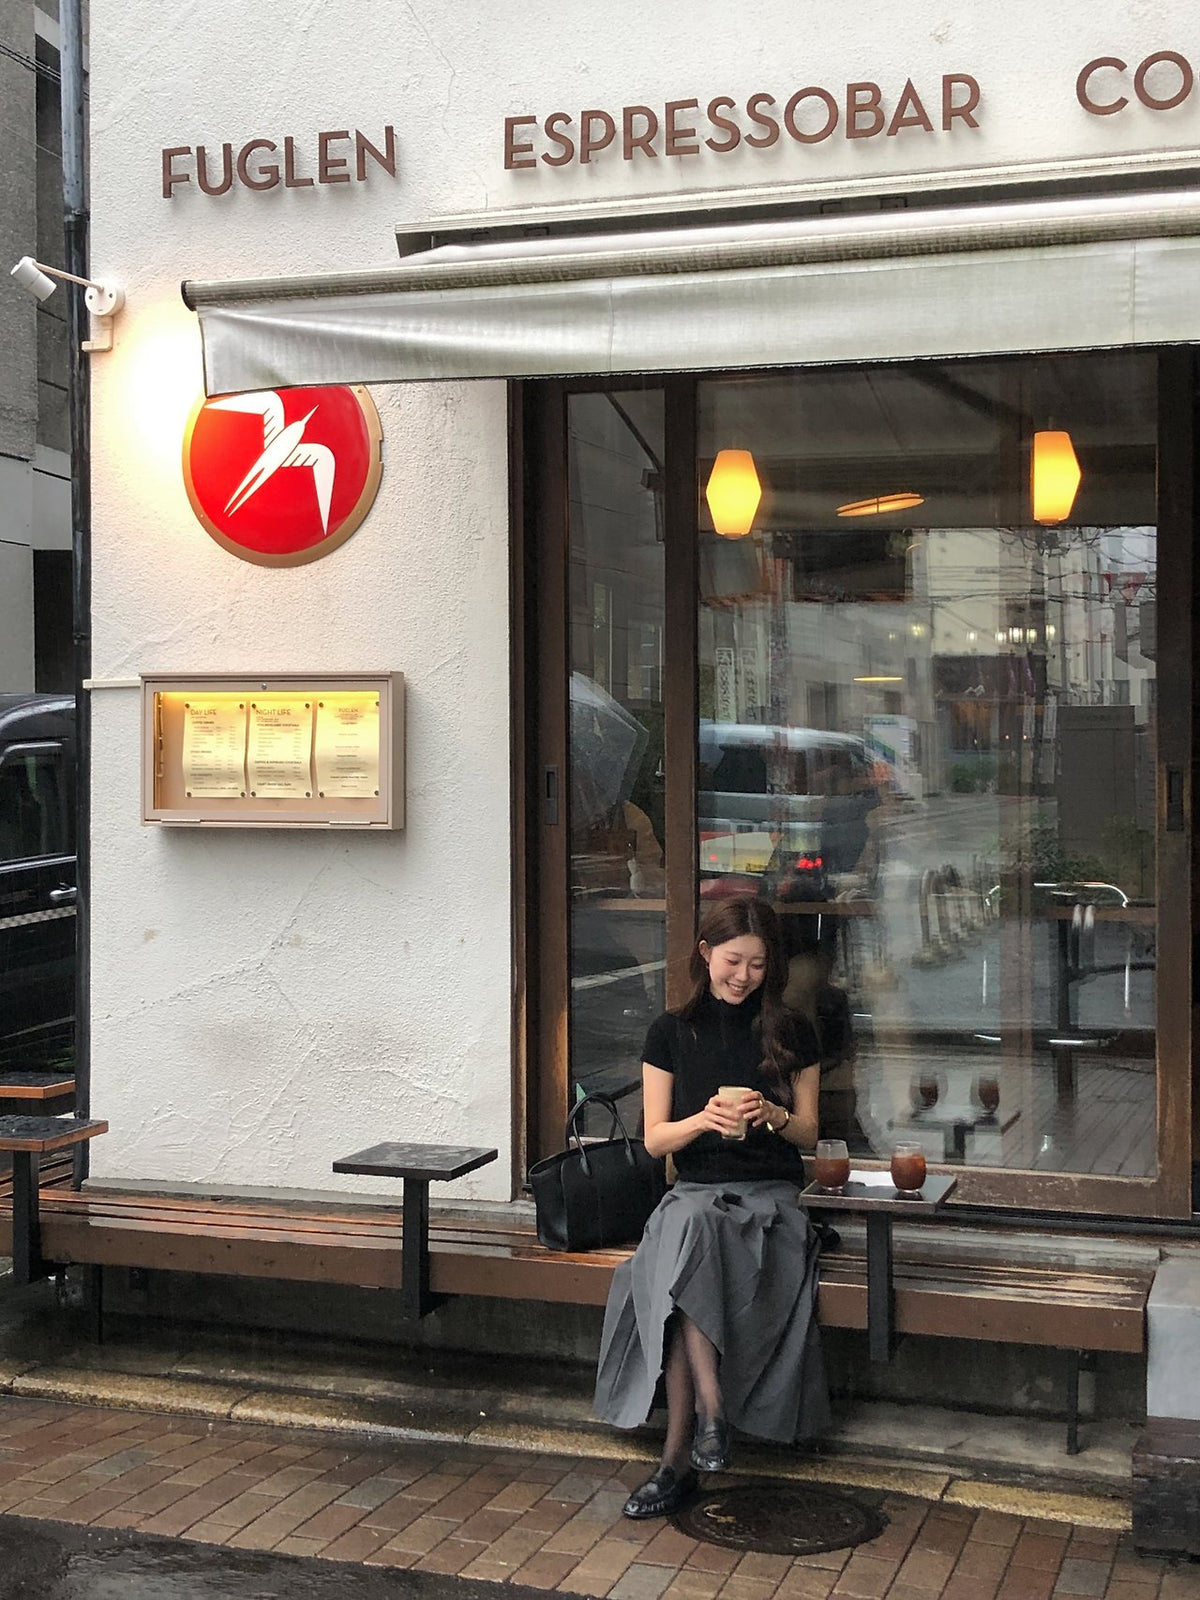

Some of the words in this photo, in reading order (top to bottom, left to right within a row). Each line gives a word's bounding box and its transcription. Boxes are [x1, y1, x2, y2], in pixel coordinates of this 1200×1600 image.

[162, 125, 397, 199] FUGLEN
[504, 74, 980, 170] ESPRESSOBAR
[1076, 50, 1200, 116] CO
